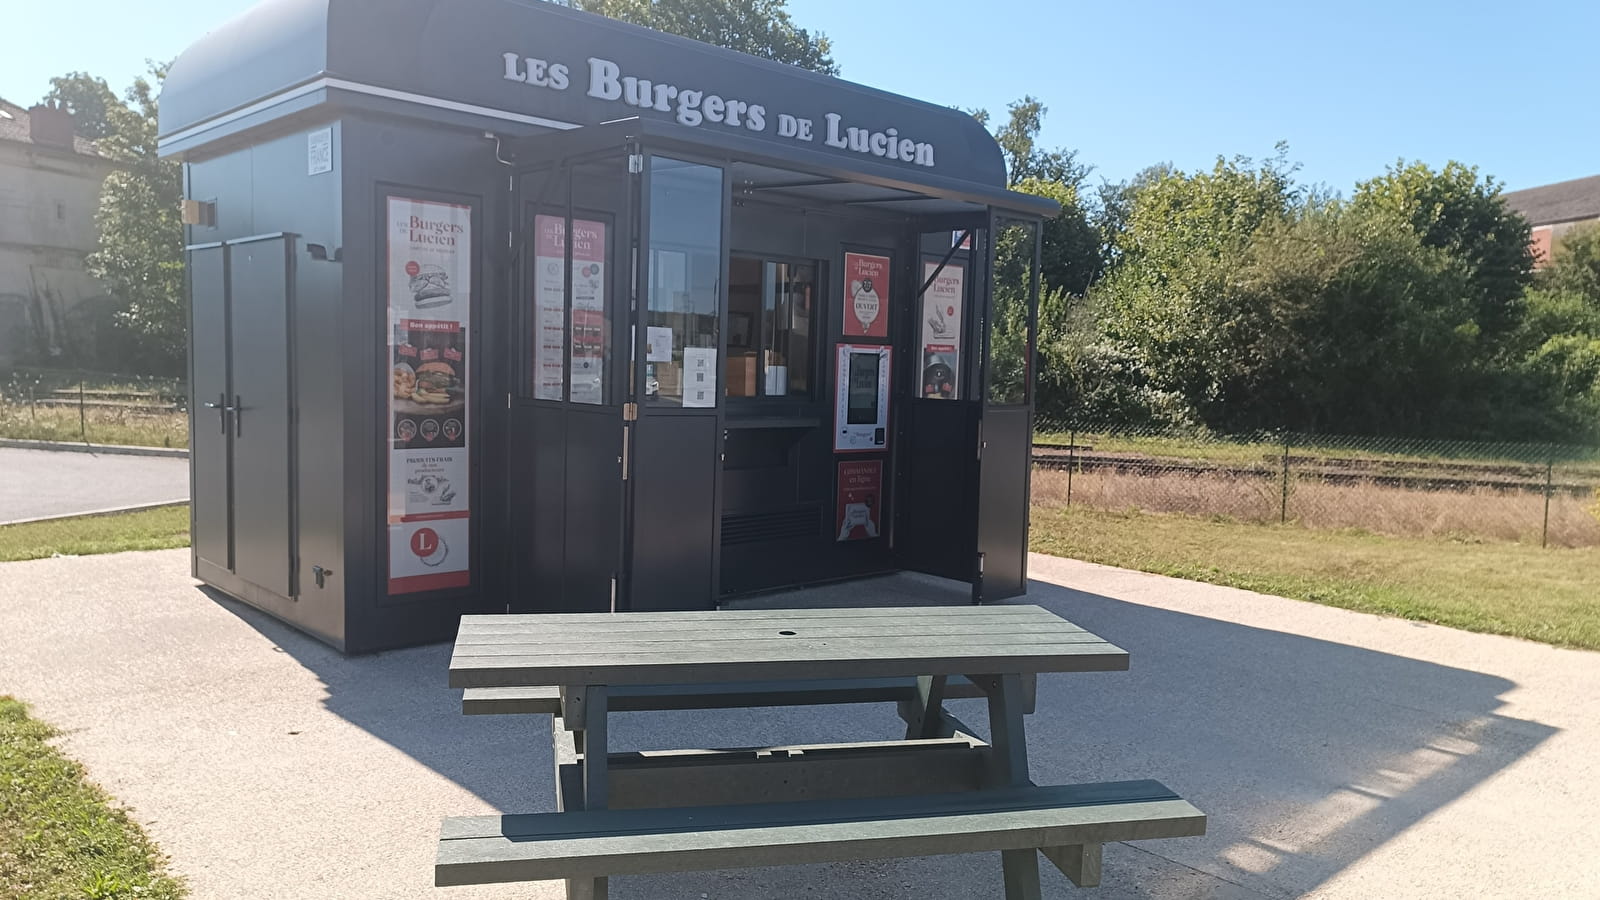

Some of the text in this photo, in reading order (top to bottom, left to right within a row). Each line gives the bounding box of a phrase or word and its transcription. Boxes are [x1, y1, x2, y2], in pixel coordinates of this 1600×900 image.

[503, 52, 936, 168] LES Burgers DE Lucien
[409, 215, 464, 234] Burgers
[554, 223, 599, 240] Bgers
[409, 229, 456, 246] Lucien
[419, 533, 432, 551] L
